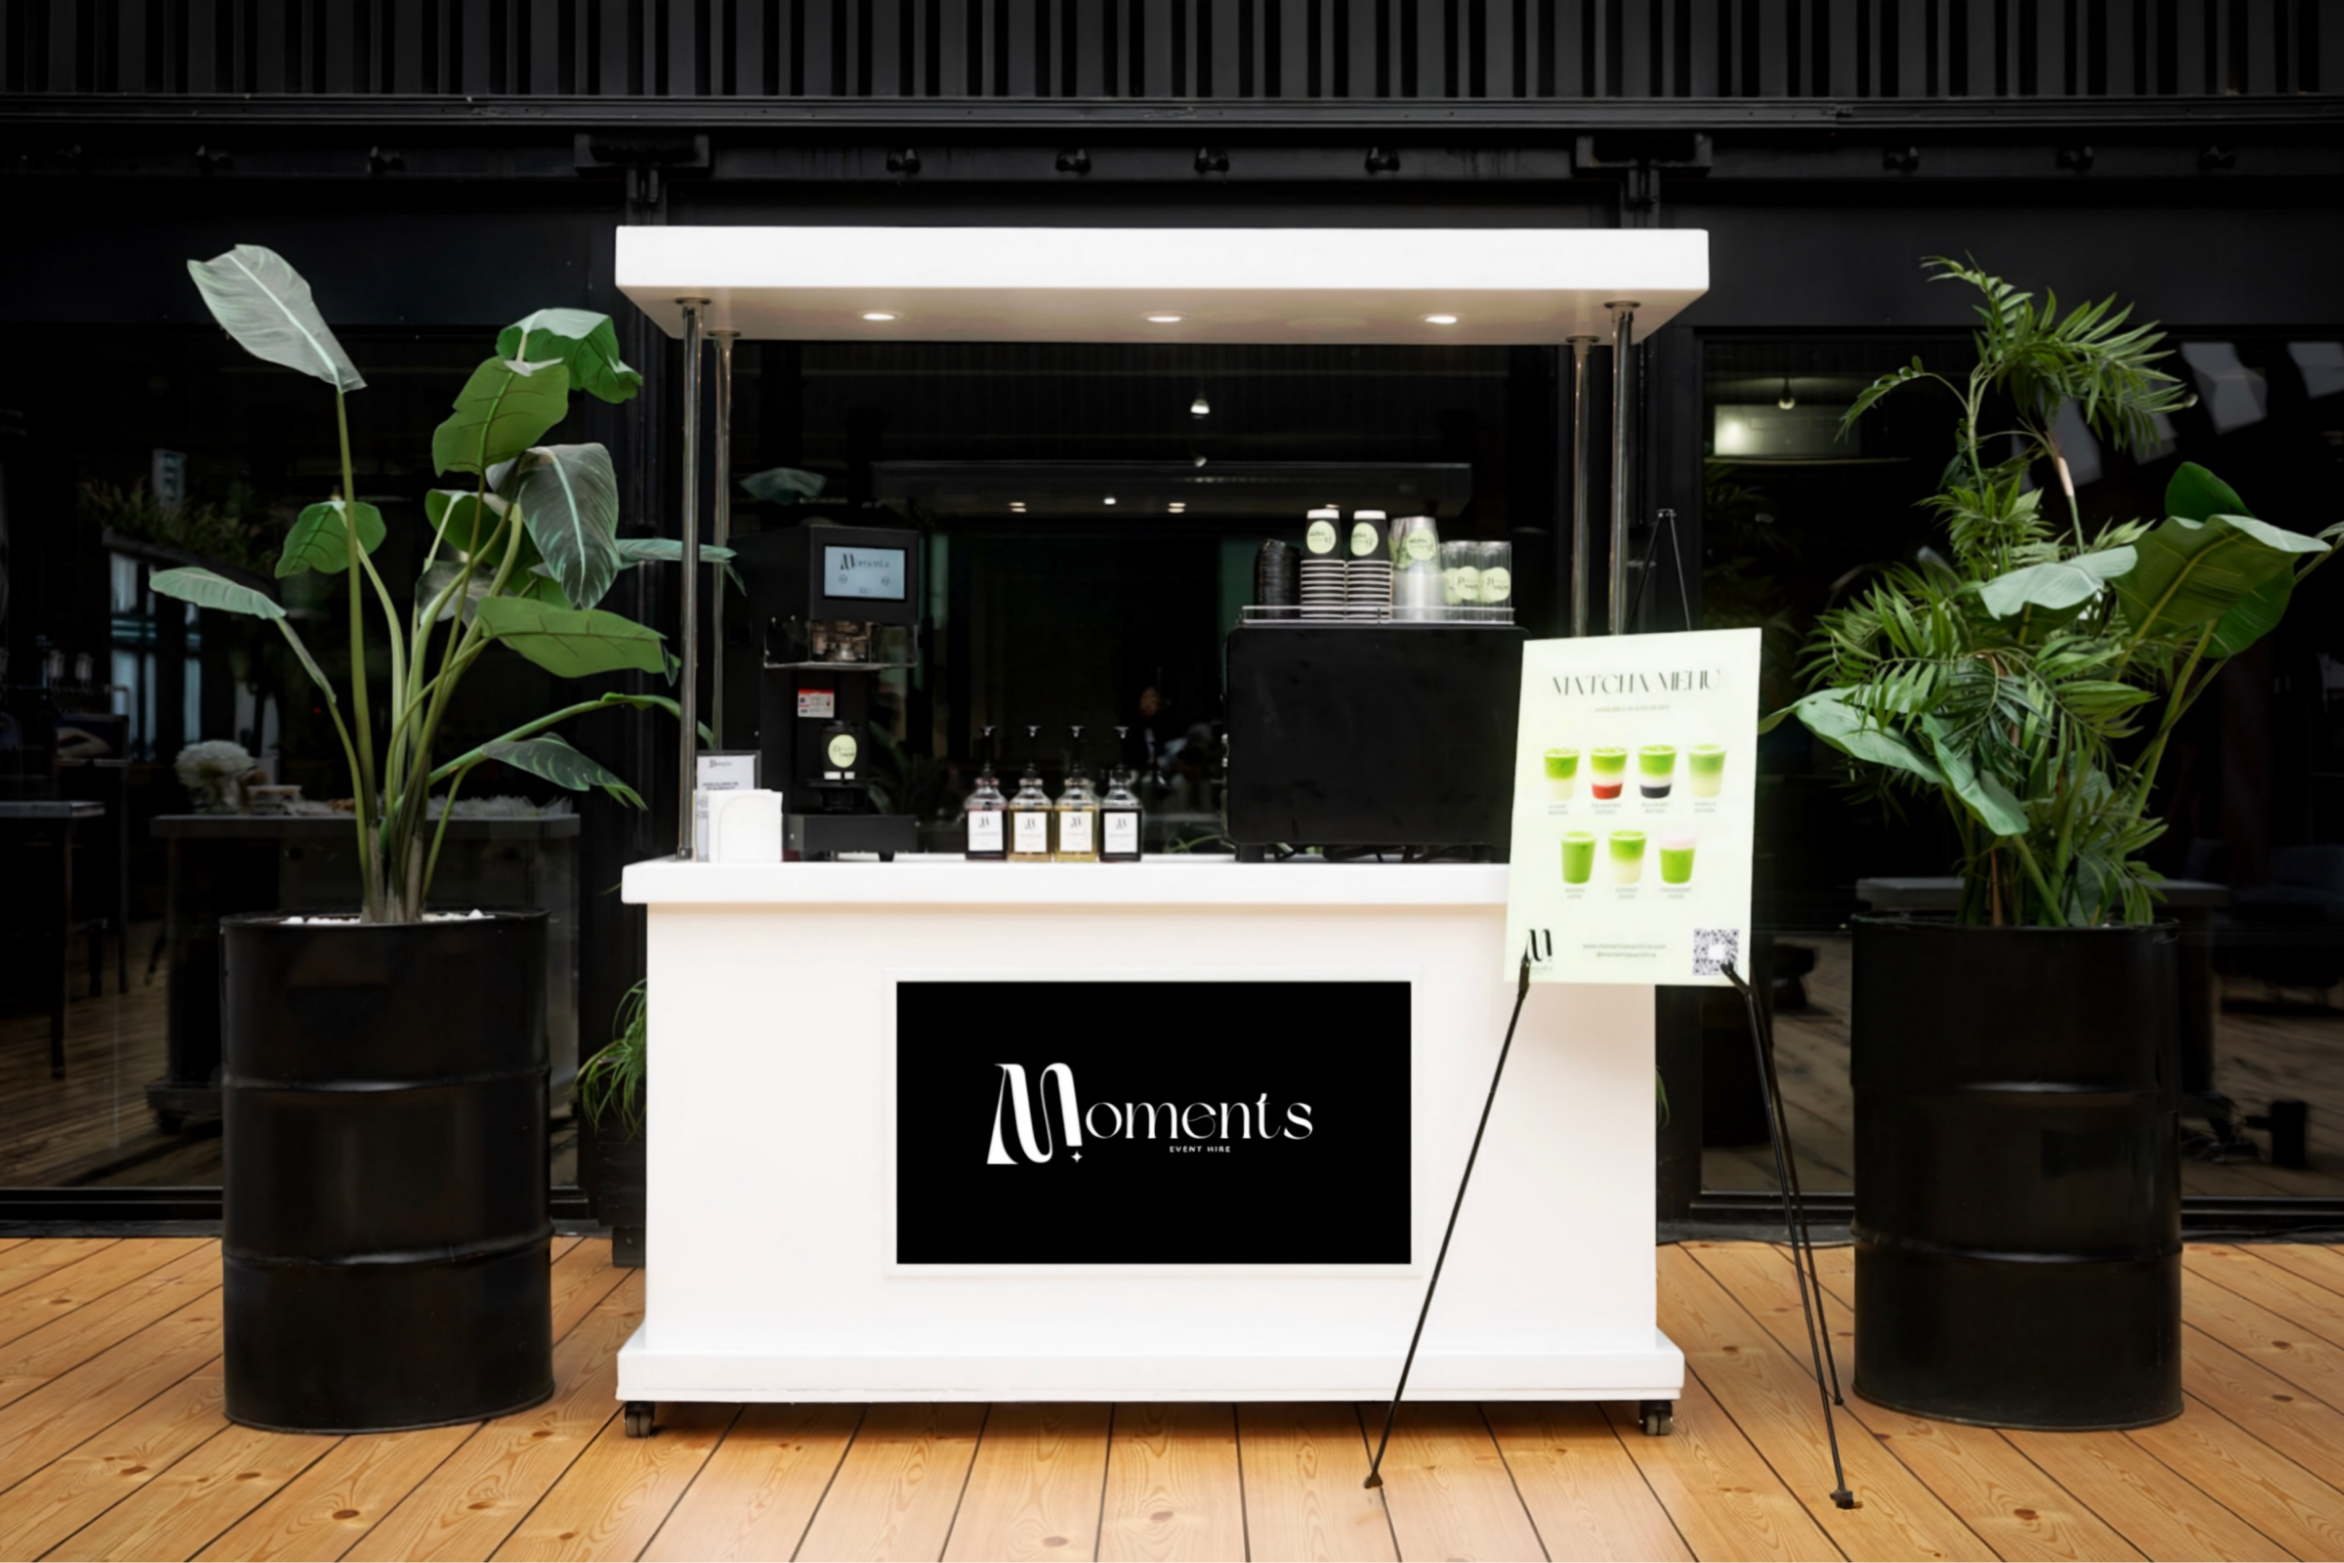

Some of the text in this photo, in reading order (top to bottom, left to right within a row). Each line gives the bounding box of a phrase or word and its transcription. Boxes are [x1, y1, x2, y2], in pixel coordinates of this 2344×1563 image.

[1551, 668, 1721, 697] MATCHA MENU
[986, 1062, 1314, 1165] Moments
[1169, 1145, 1232, 1153] EVENT HIRE
